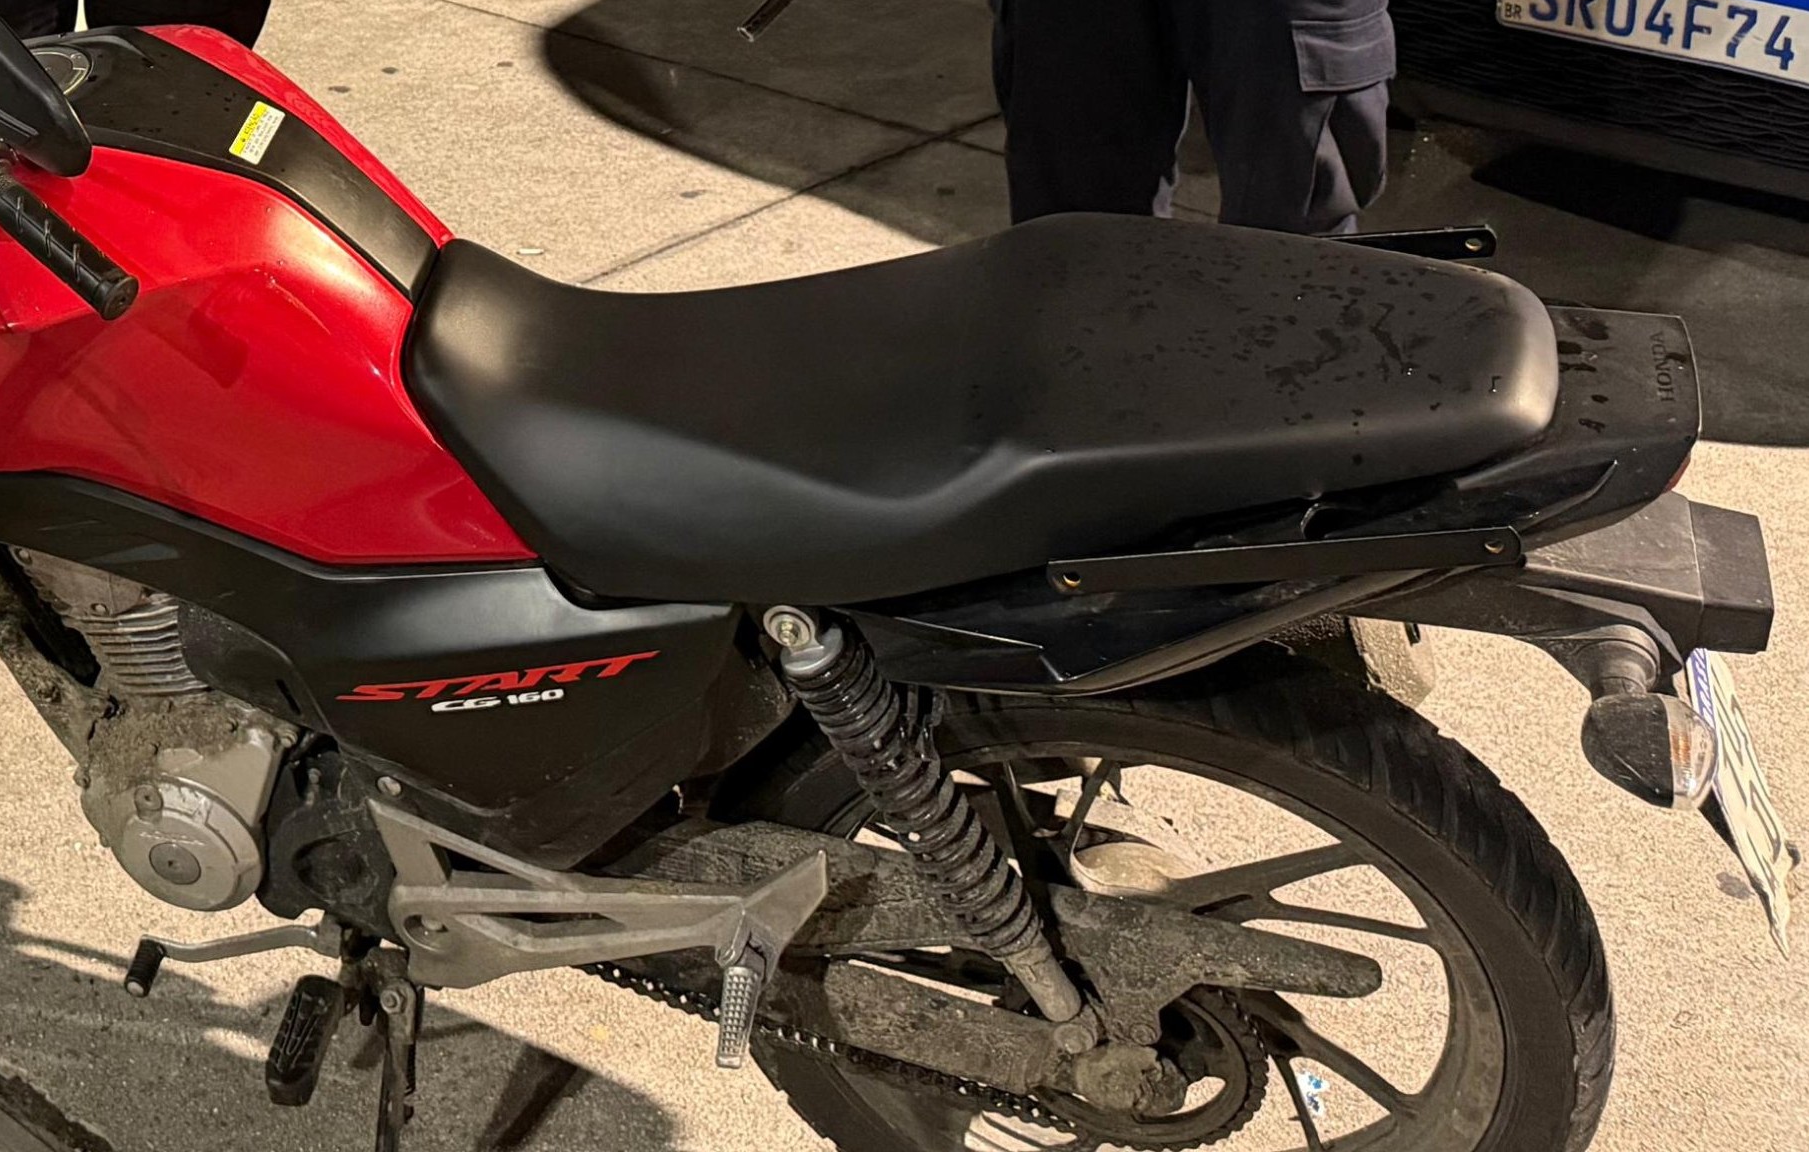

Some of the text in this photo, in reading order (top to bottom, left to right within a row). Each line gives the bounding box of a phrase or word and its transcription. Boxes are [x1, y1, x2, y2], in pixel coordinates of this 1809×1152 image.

[1504, 1, 1522, 20] BR
[1649, 330, 1675, 403] HONDA
[336, 650, 661, 701] START
[431, 688, 565, 713] CG 160
